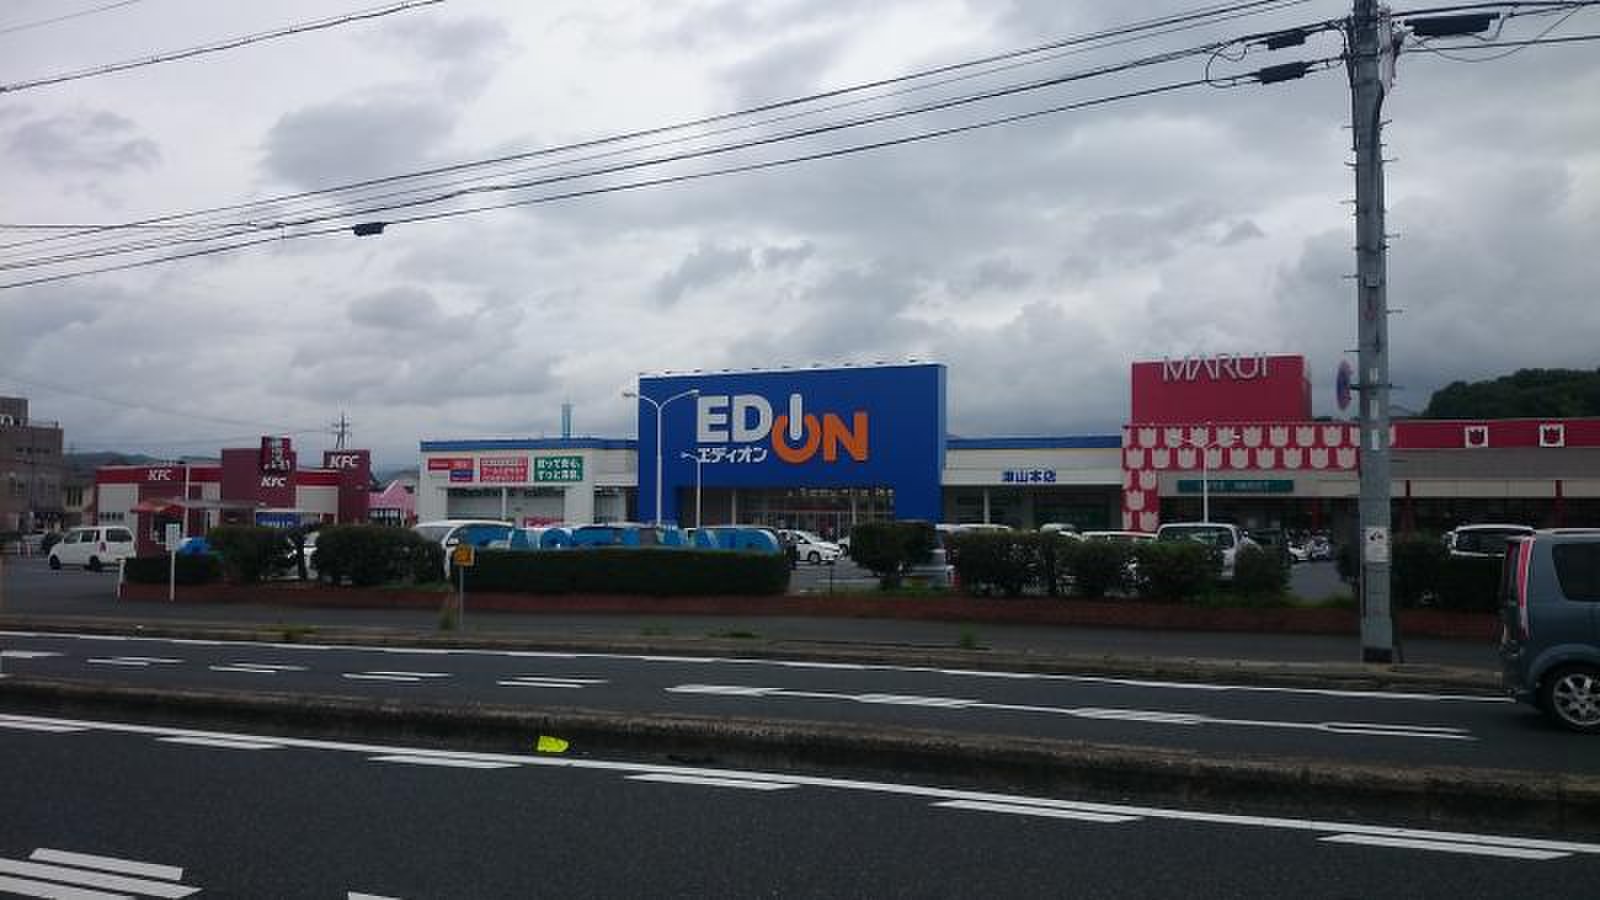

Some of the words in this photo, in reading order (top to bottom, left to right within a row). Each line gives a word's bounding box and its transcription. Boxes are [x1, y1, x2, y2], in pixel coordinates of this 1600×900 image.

[1162, 353, 1268, 382] MARUI
[696, 393, 869, 463] EDION
[329, 454, 361, 469] KFC
[697, 447, 768, 464] エディオン
[147, 469, 173, 481] KFC
[260, 475, 287, 487] KFC
